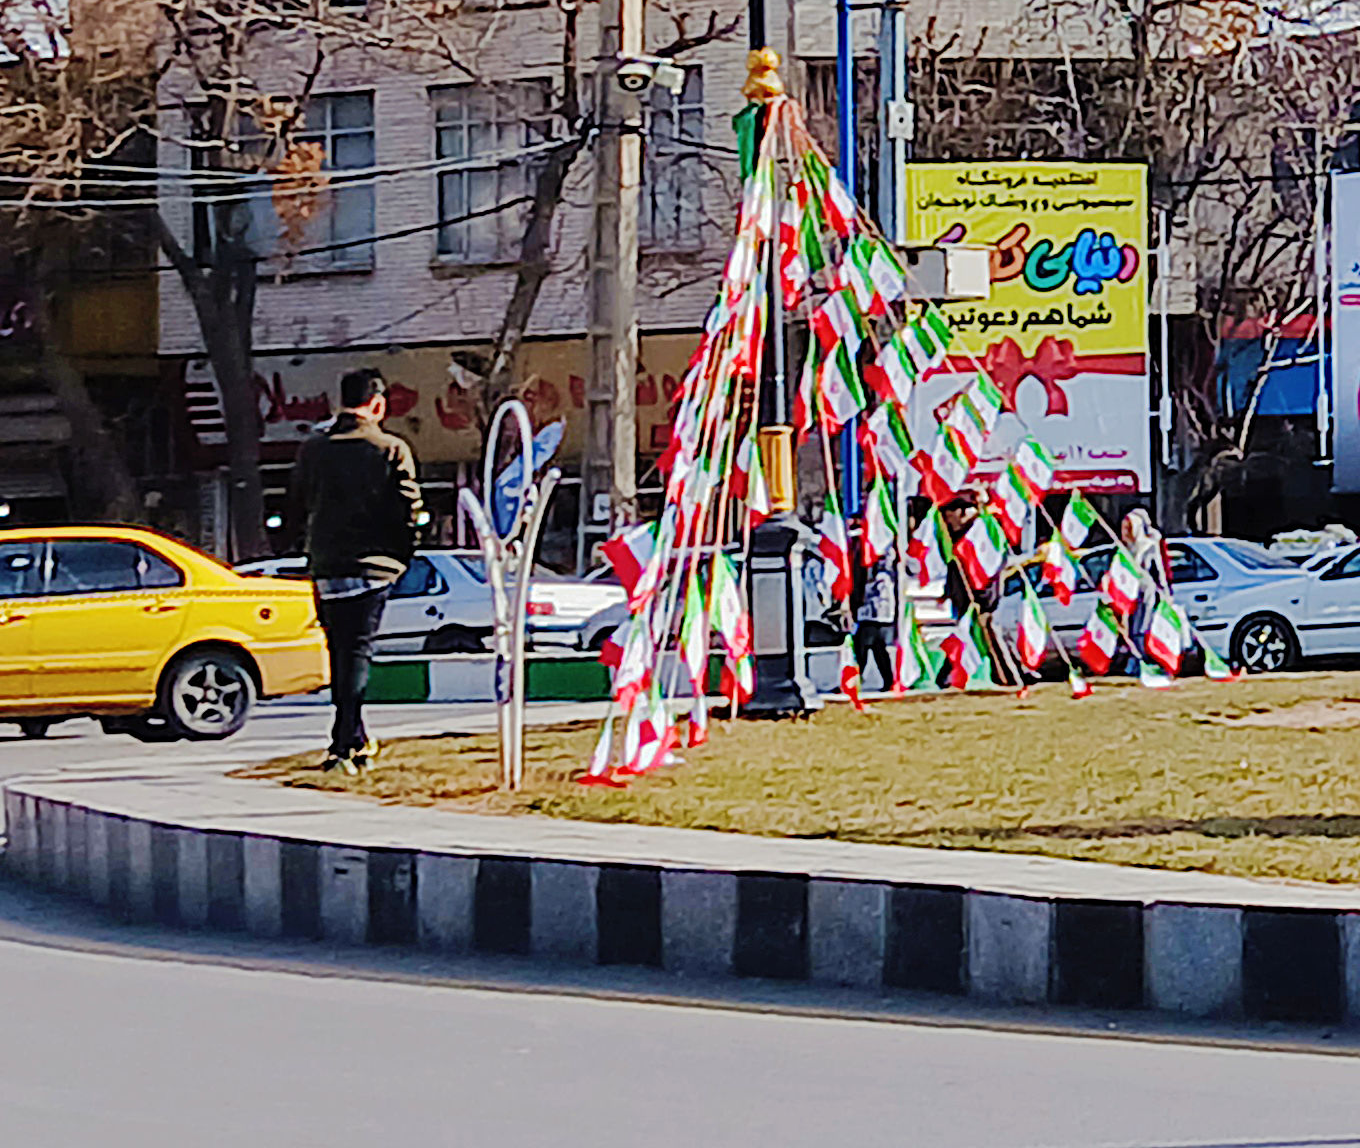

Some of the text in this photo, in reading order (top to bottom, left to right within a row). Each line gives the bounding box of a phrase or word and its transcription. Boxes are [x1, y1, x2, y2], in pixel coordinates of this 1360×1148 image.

[1025, 227, 1140, 296] دنیای
[1021, 308, 1064, 332] هم
[1067, 303, 1113, 329] شما
